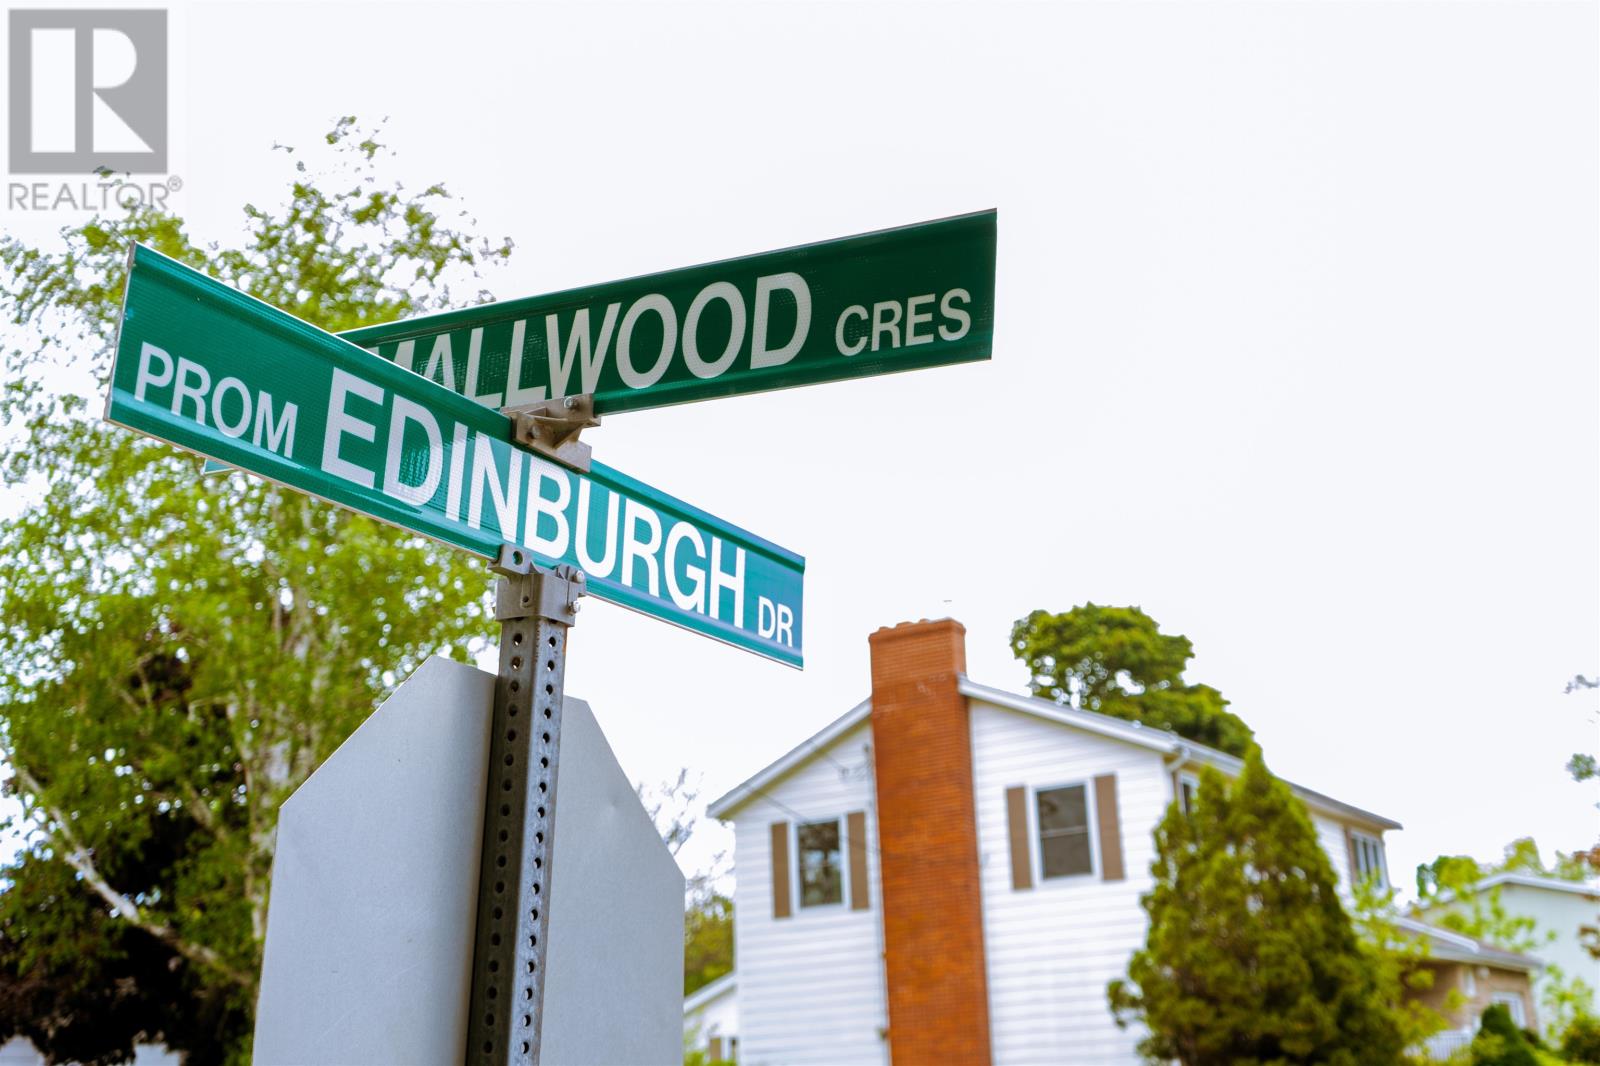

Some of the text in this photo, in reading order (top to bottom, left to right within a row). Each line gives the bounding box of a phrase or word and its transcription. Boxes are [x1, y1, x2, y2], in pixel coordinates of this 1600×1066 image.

[364, 271, 972, 409] ALLWOOD CRES
[133, 341, 794, 648] PROM EDINBURGH DR
